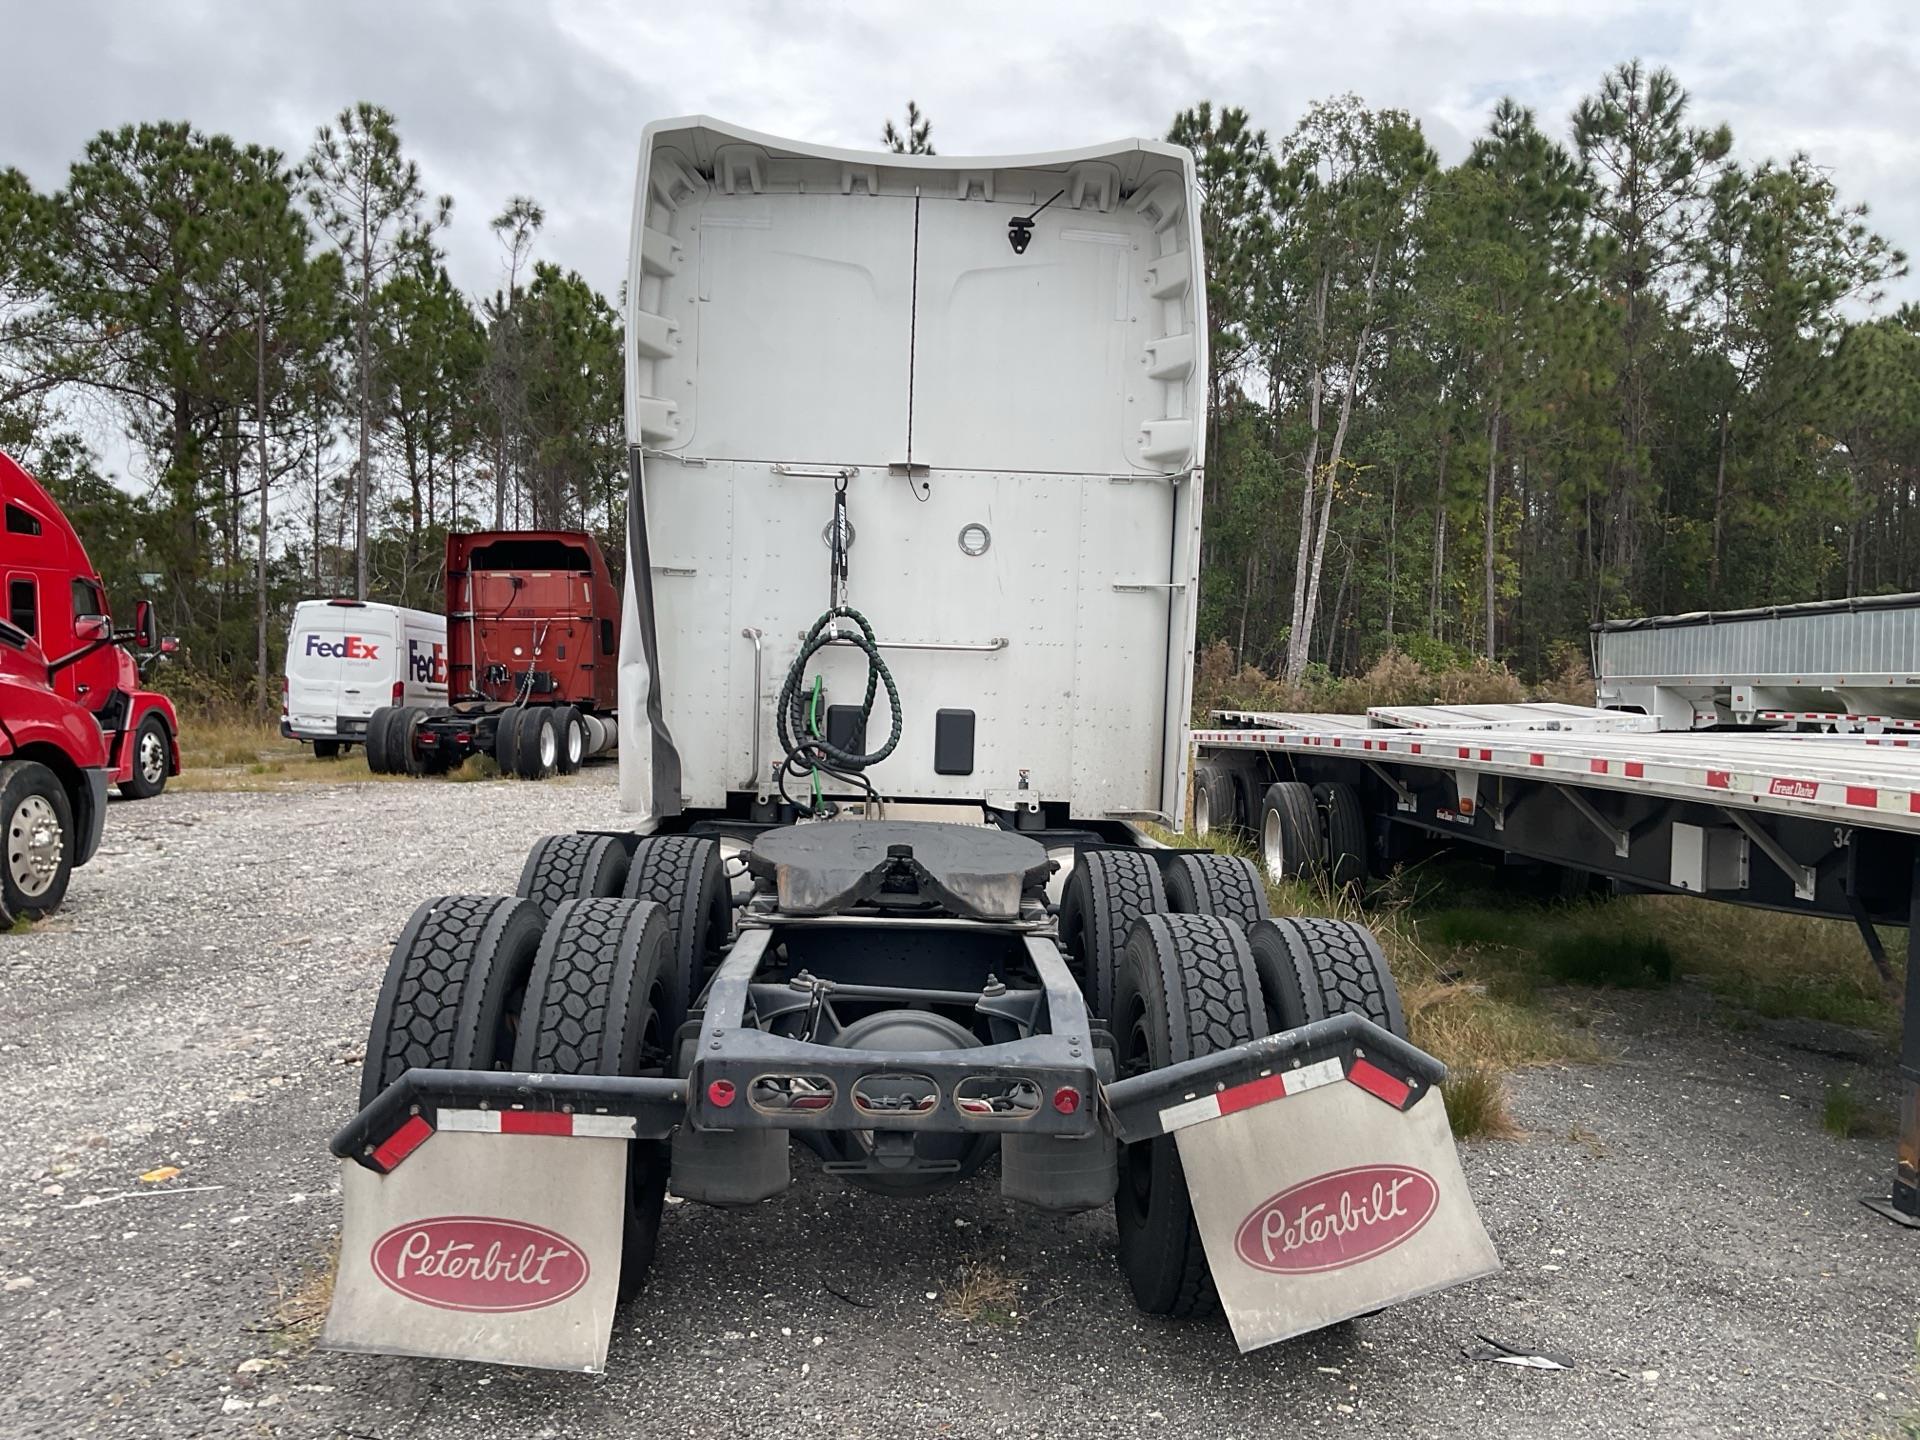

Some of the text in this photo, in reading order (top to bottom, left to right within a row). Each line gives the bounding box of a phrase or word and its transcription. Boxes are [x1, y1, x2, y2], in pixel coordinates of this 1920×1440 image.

[306, 634, 379, 660] FedEx
[1772, 780, 1816, 798] Great Dane
[1261, 1176, 1414, 1263] Peterbilt
[397, 1231, 570, 1285] Peterbilt
